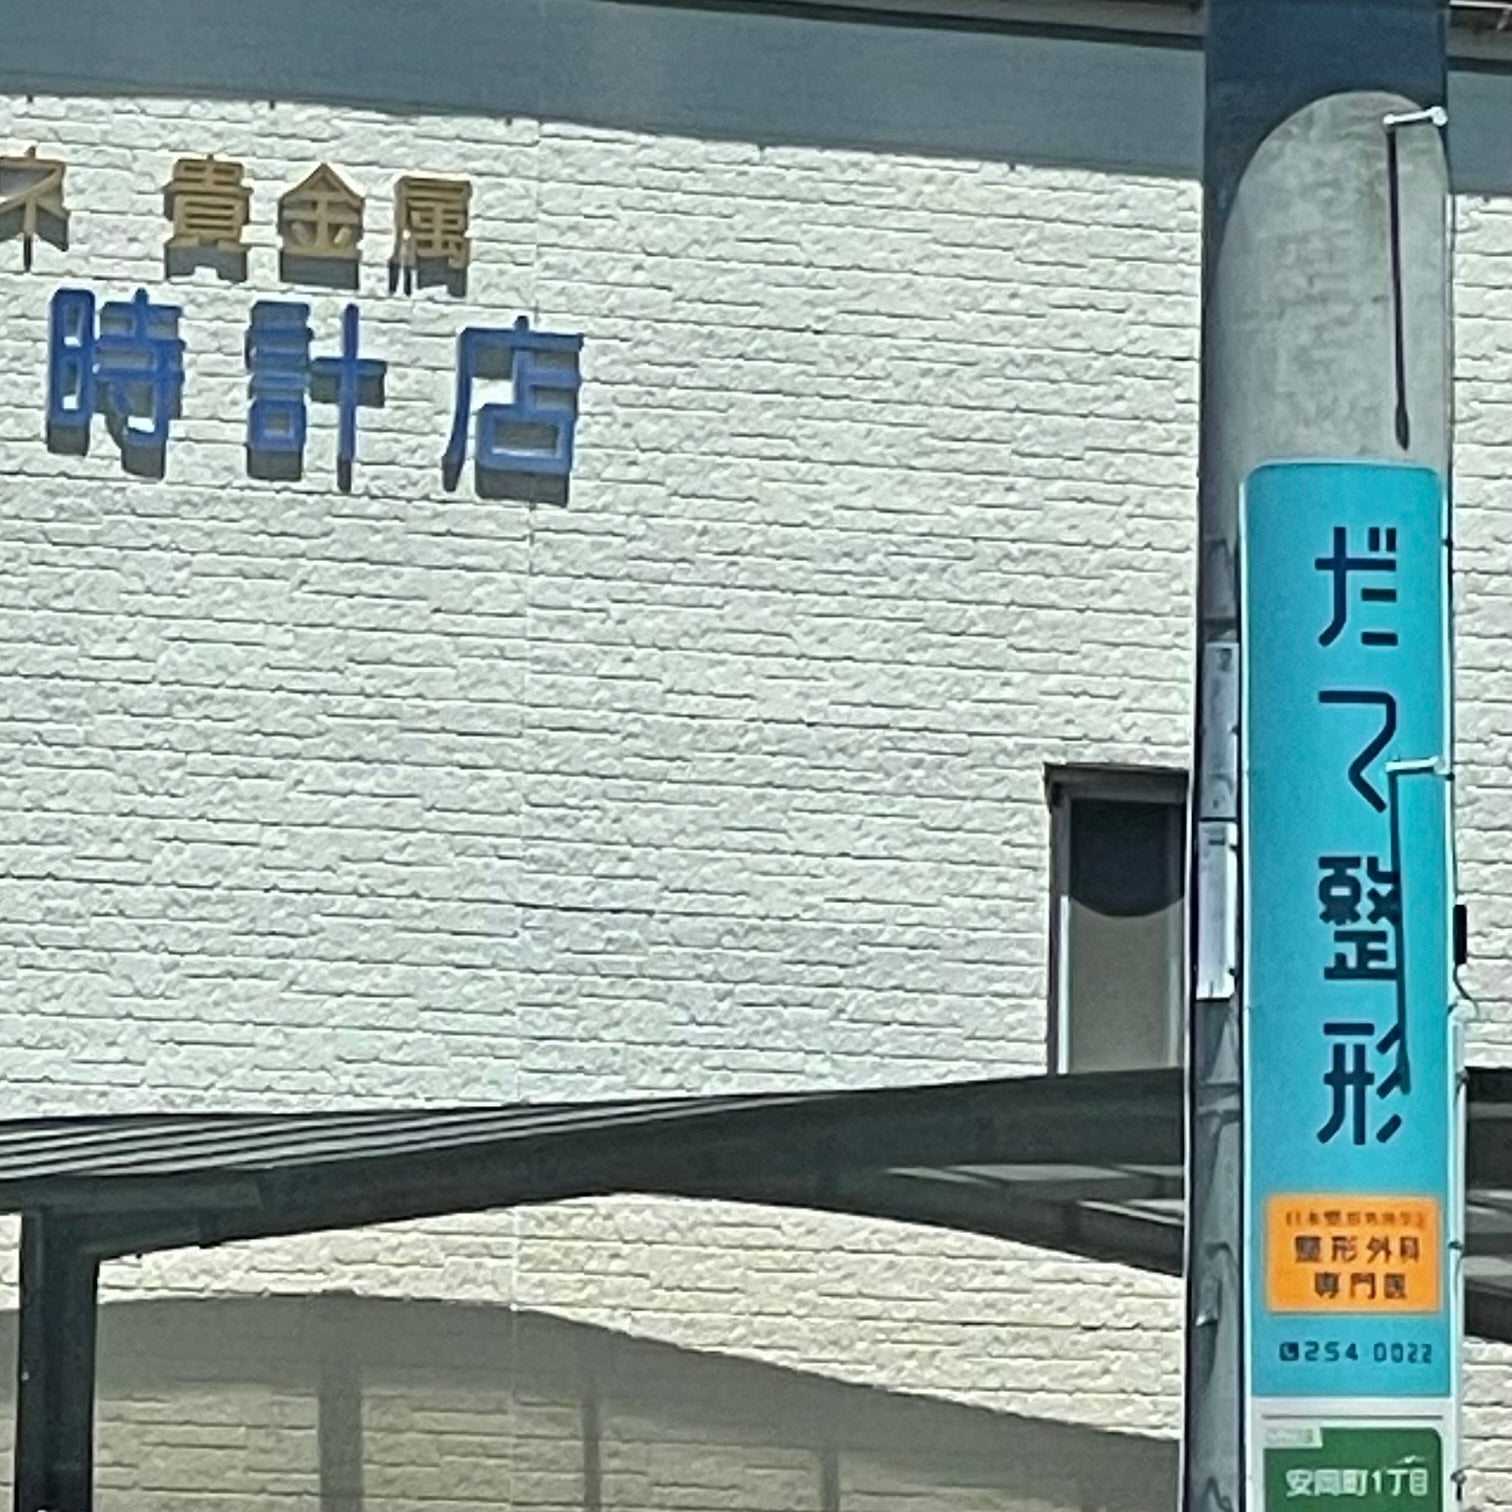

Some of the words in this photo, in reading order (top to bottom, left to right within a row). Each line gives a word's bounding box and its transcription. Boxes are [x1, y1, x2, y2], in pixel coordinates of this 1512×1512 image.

[163, 152, 473, 290] 貴金属
[1304, 1341, 1359, 1362] 254
